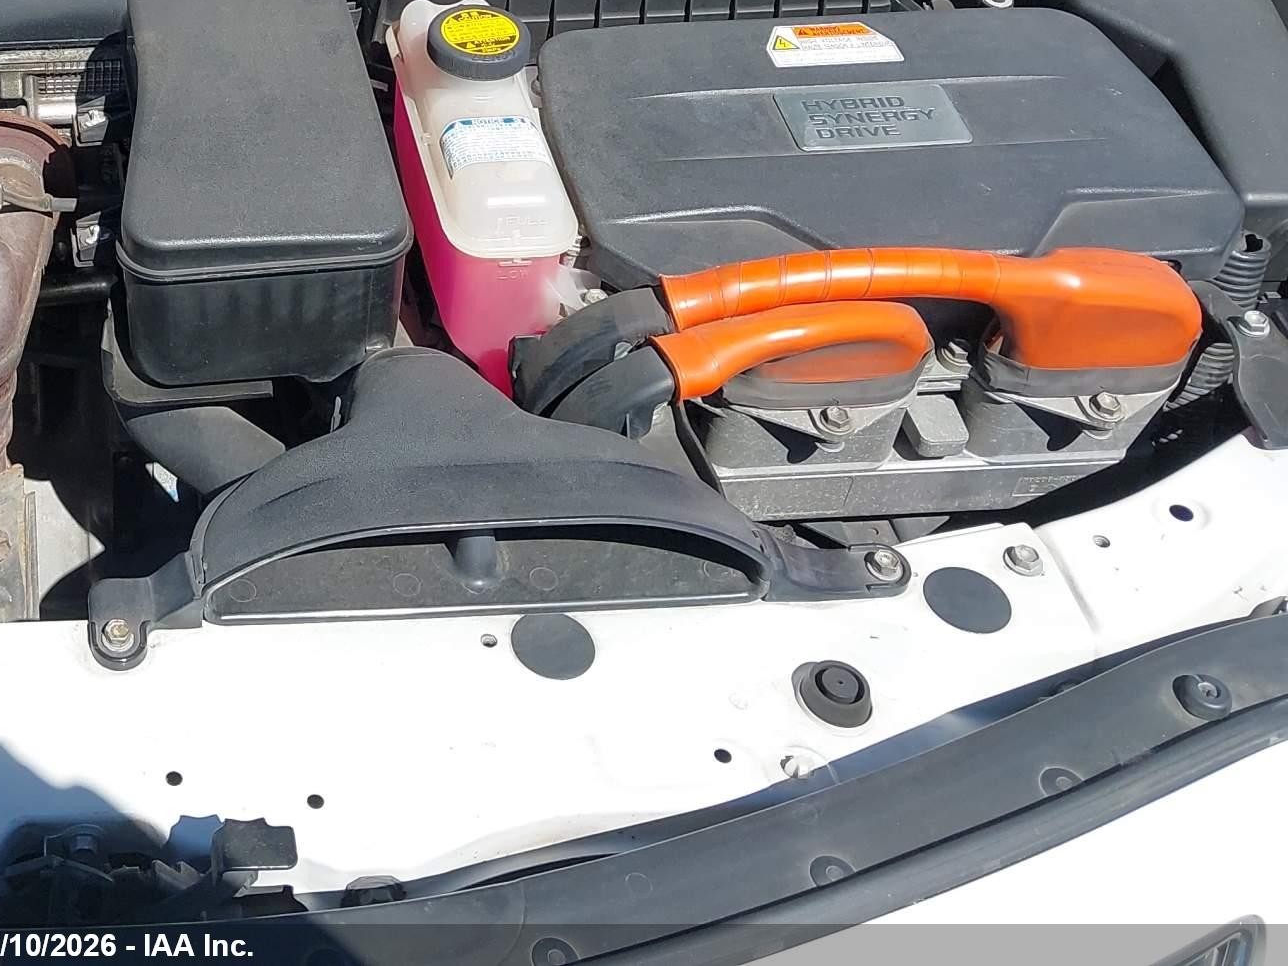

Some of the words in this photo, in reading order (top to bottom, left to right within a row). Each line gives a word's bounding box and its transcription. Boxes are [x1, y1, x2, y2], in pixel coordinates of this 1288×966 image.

[801, 96, 905, 112] HYBRID
[809, 108, 935, 126] SYNERGY
[816, 125, 901, 139] DRIVE
